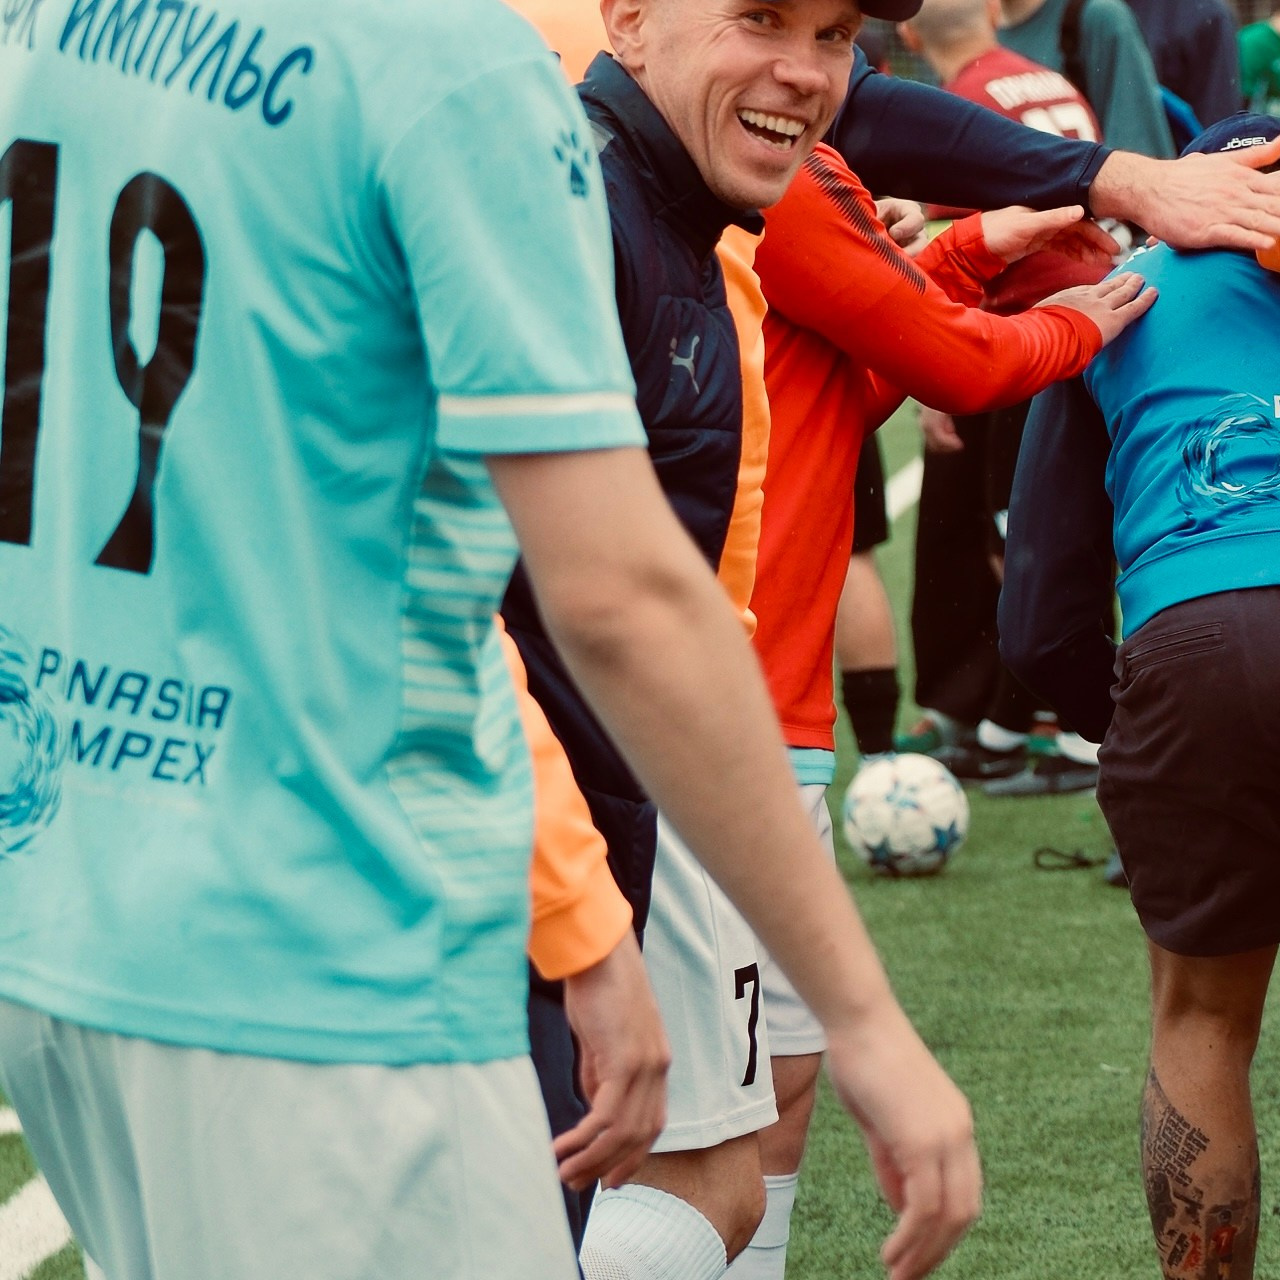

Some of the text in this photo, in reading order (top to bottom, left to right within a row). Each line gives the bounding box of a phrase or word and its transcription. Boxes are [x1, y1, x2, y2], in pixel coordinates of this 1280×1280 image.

[0, 138, 208, 575] 19
[35, 647, 233, 729] PNASIA
[70, 719, 216, 785] MPEX
[734, 962, 760, 1087] 7
